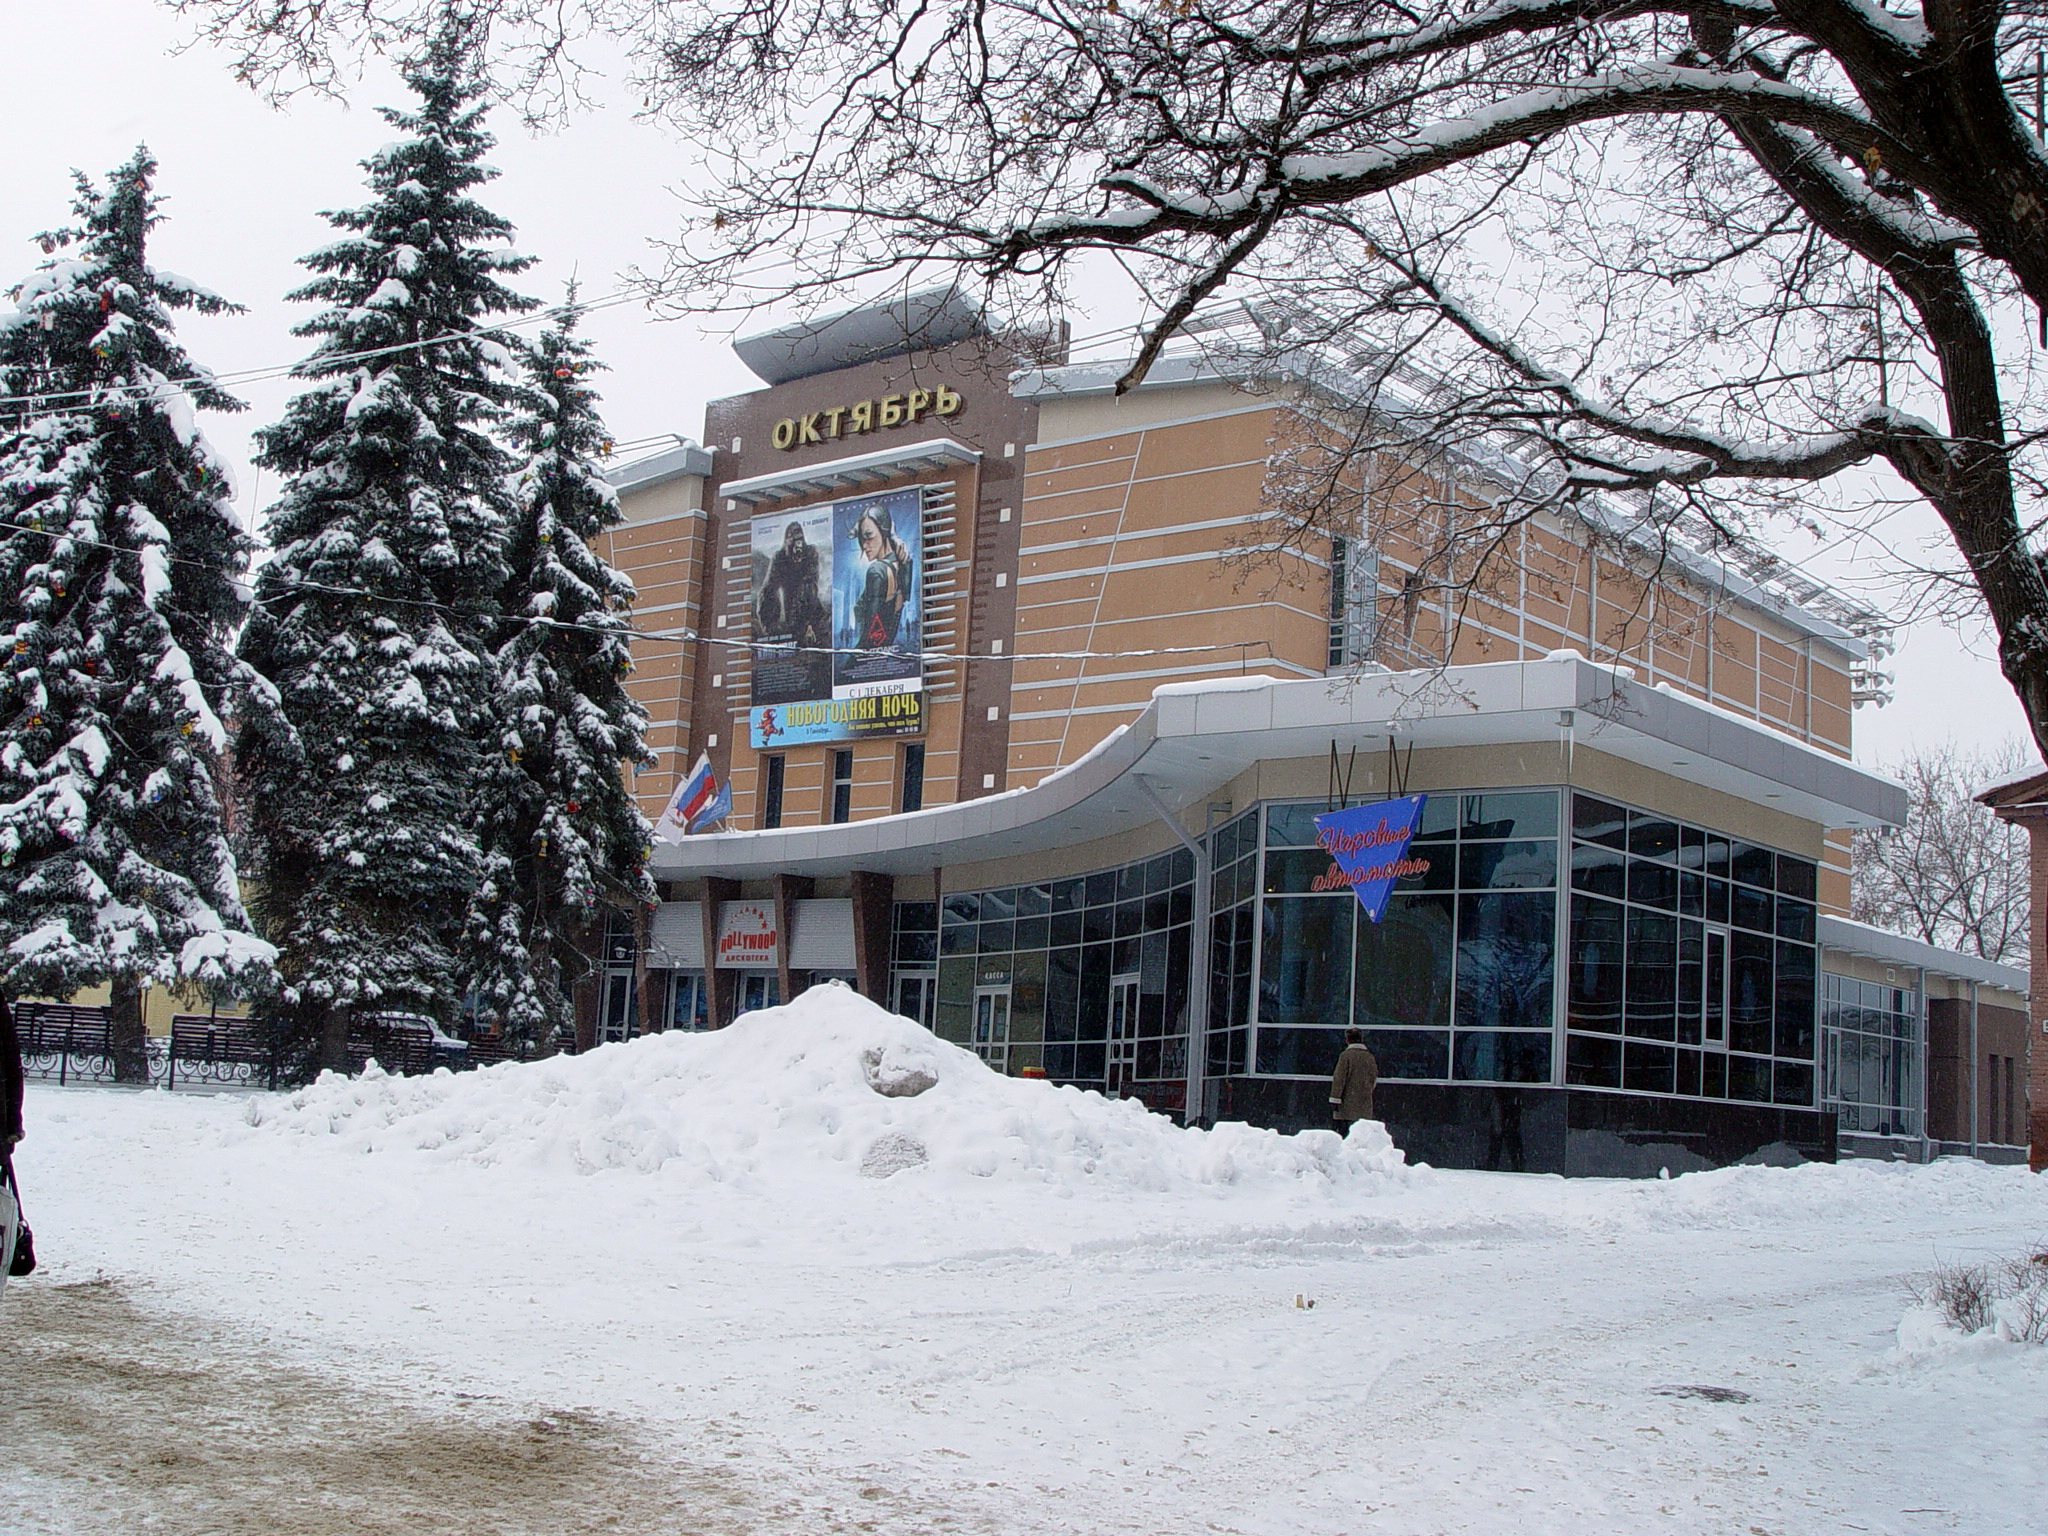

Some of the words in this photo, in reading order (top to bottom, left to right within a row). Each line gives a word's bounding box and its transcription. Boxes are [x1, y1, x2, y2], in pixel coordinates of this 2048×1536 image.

[772, 383, 962, 450] ОКТЯБРЬ
[864, 684, 905, 697] ДЕКАБРЯ
[787, 698, 876, 727] НОВОГОДНЯЯ
[882, 693, 920, 718] НОЧЬ
[1316, 818, 1411, 859] Игровые
[1311, 858, 1431, 892] автоматы
[721, 931, 776, 953] HOLLYWOOD
[725, 954, 769, 962] ДИСКОТЕКА
[985, 971, 1004, 979] КАССА
